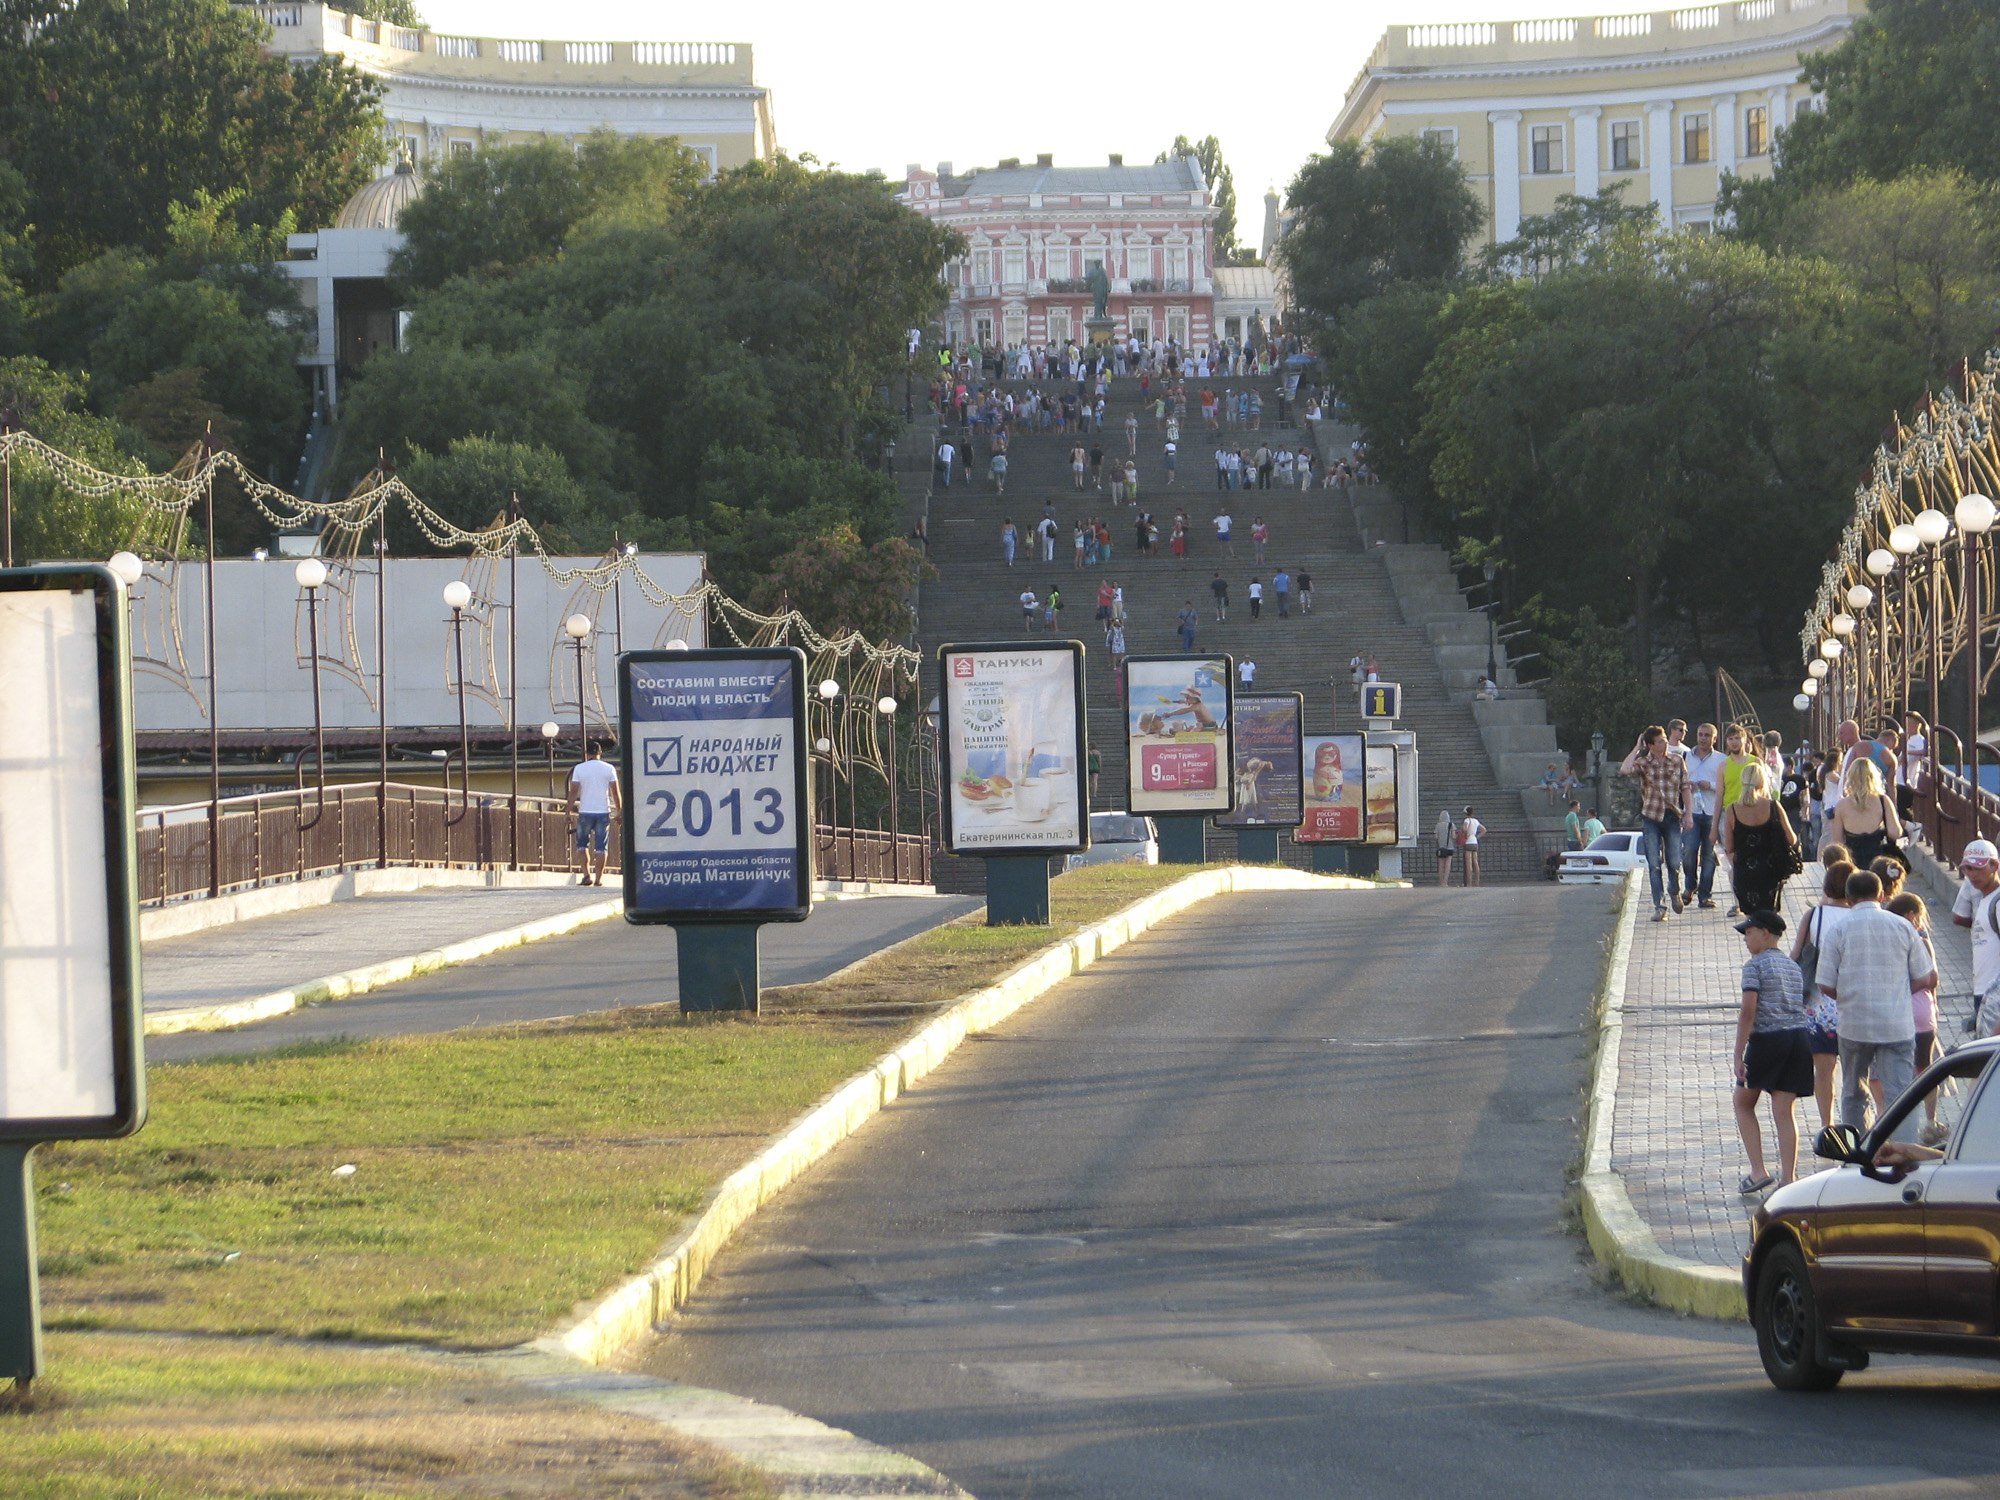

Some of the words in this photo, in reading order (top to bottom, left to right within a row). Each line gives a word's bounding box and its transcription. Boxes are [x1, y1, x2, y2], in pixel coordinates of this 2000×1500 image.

[977, 658, 1043, 668] ТАНУКИ
[636, 677, 715, 689] СОСТАВИМ
[719, 675, 775, 687] ВМЕСТЕ
[652, 695, 696, 706] ЛЮДИ
[701, 695, 710, 704] И
[715, 693, 770, 704] ВЛАСТЬ
[964, 696, 1004, 706] ЛЕТНИЙ
[963, 716, 1006, 732] ЗАВТРАК
[689, 734, 783, 754] НАРОДНЫЙ
[964, 735, 1008, 743] НАПИТОК
[686, 754, 779, 776] БЮДЖЕТ
[1151, 763, 1161, 781] 9
[646, 787, 785, 837] 2013
[1316, 817, 1335, 827] 0,15
[959, 831, 1043, 843] Екатерининская
[1046, 830, 1065, 840] пл.,
[1067, 829, 1073, 838] 3
[641, 858, 699, 868] Губернатор
[700, 856, 749, 867] Одесской
[750, 855, 791, 865] области
[642, 869, 701, 885] Эдуард
[705, 867, 791, 882] Матвийчук
